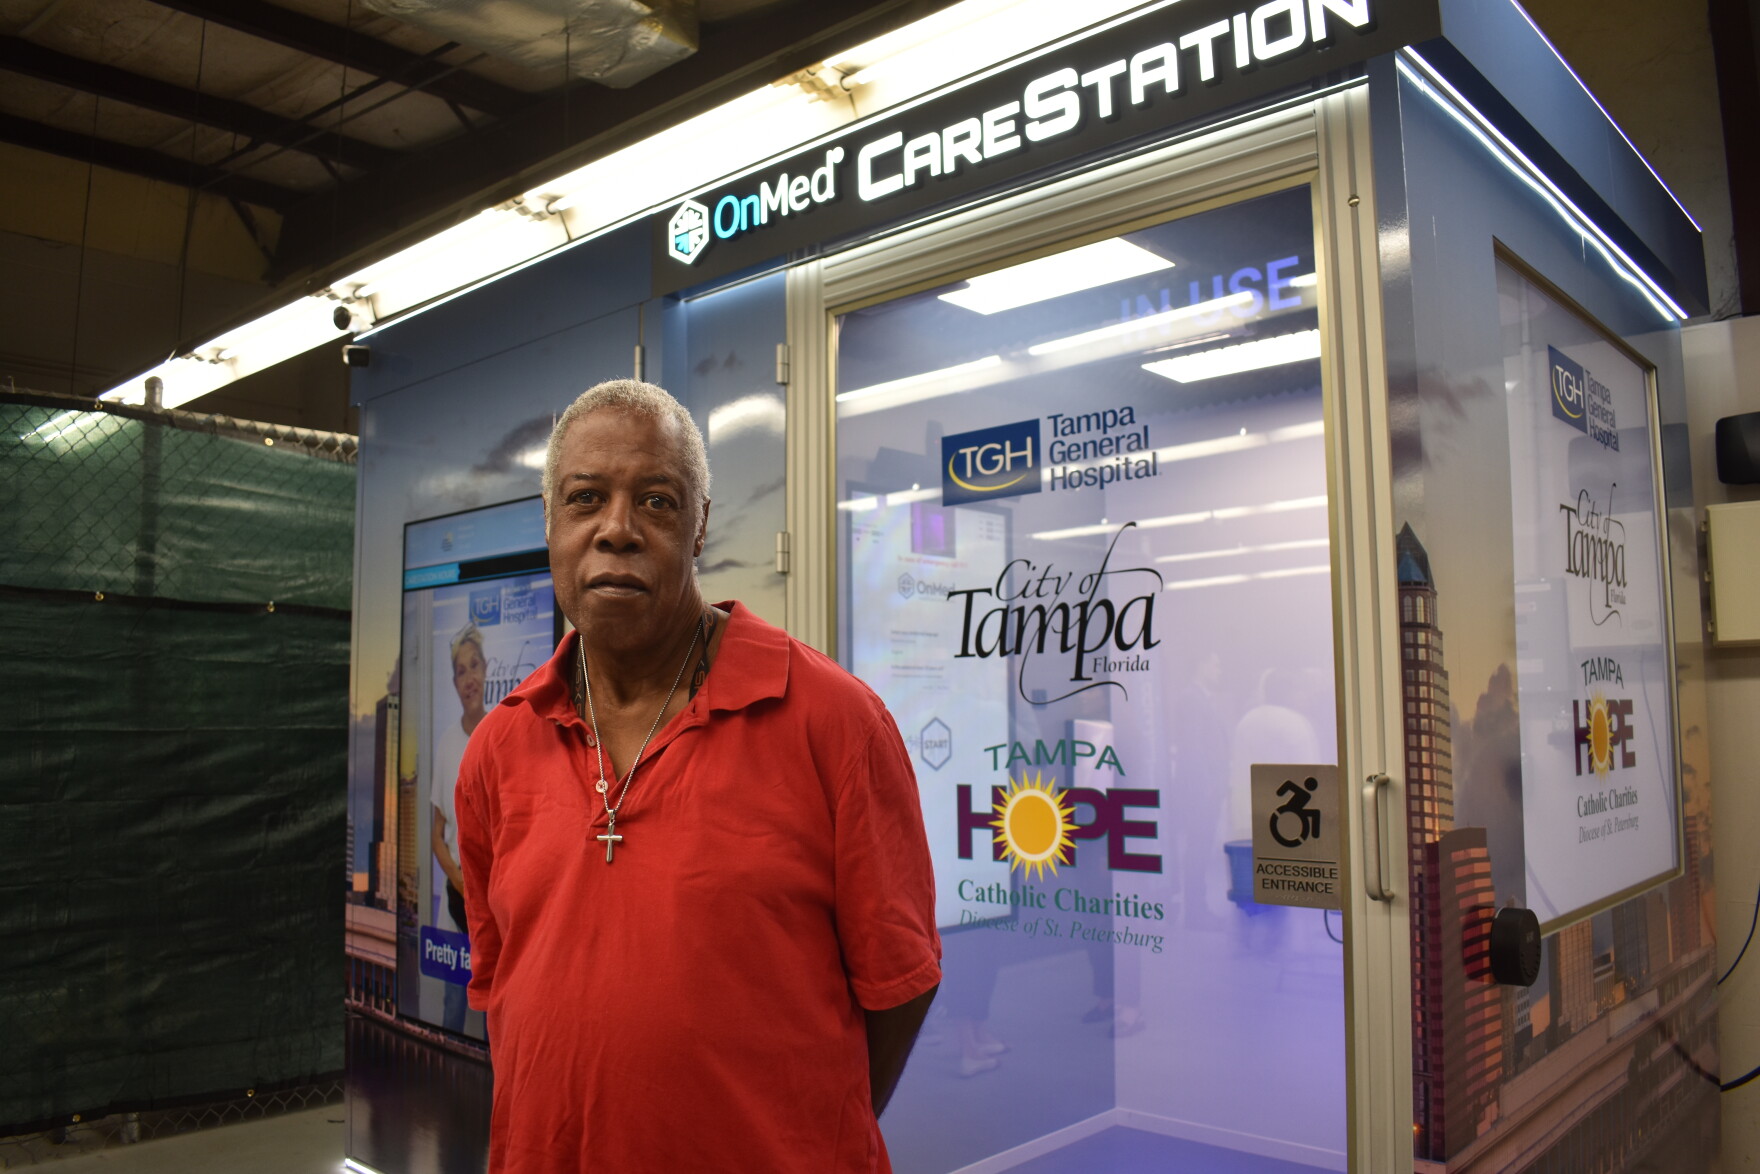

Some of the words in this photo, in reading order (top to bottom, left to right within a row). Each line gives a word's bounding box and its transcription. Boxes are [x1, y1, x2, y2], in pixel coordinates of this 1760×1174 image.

[714, 147, 836, 239] OnMed
[1189, 256, 1302, 327] USE
[1555, 364, 1584, 409] TGH
[1585, 369, 1612, 405] Tampa
[1047, 406, 1136, 438] Tampa
[1587, 394, 1616, 429] General
[1049, 425, 1149, 465] General
[1589, 416, 1620, 452] Hospital
[959, 436, 1032, 478] TGH
[1051, 451, 1158, 491] Hospital
[1560, 503, 1627, 608] Tampa
[995, 558, 1073, 606] City
[947, 588, 1160, 682] Tampa
[1092, 655, 1150, 674] Florida
[1581, 656, 1625, 690] TAMPA
[984, 738, 1126, 776] TAMPA
[1577, 792, 1608, 818] Catholic
[1609, 786, 1638, 810] Charities
[1256, 863, 1338, 880] ACCESSIBLE
[1262, 878, 1334, 895] ENTRANCE
[958, 879, 1047, 909] Catholic
[1054, 887, 1165, 921] Charities
[960, 909, 1019, 932] Diocese
[1023, 917, 1043, 939] of
[1044, 918, 1064, 938] St.
[1070, 920, 1165, 954] Petersburg
[425, 938, 458, 971] Pretty
